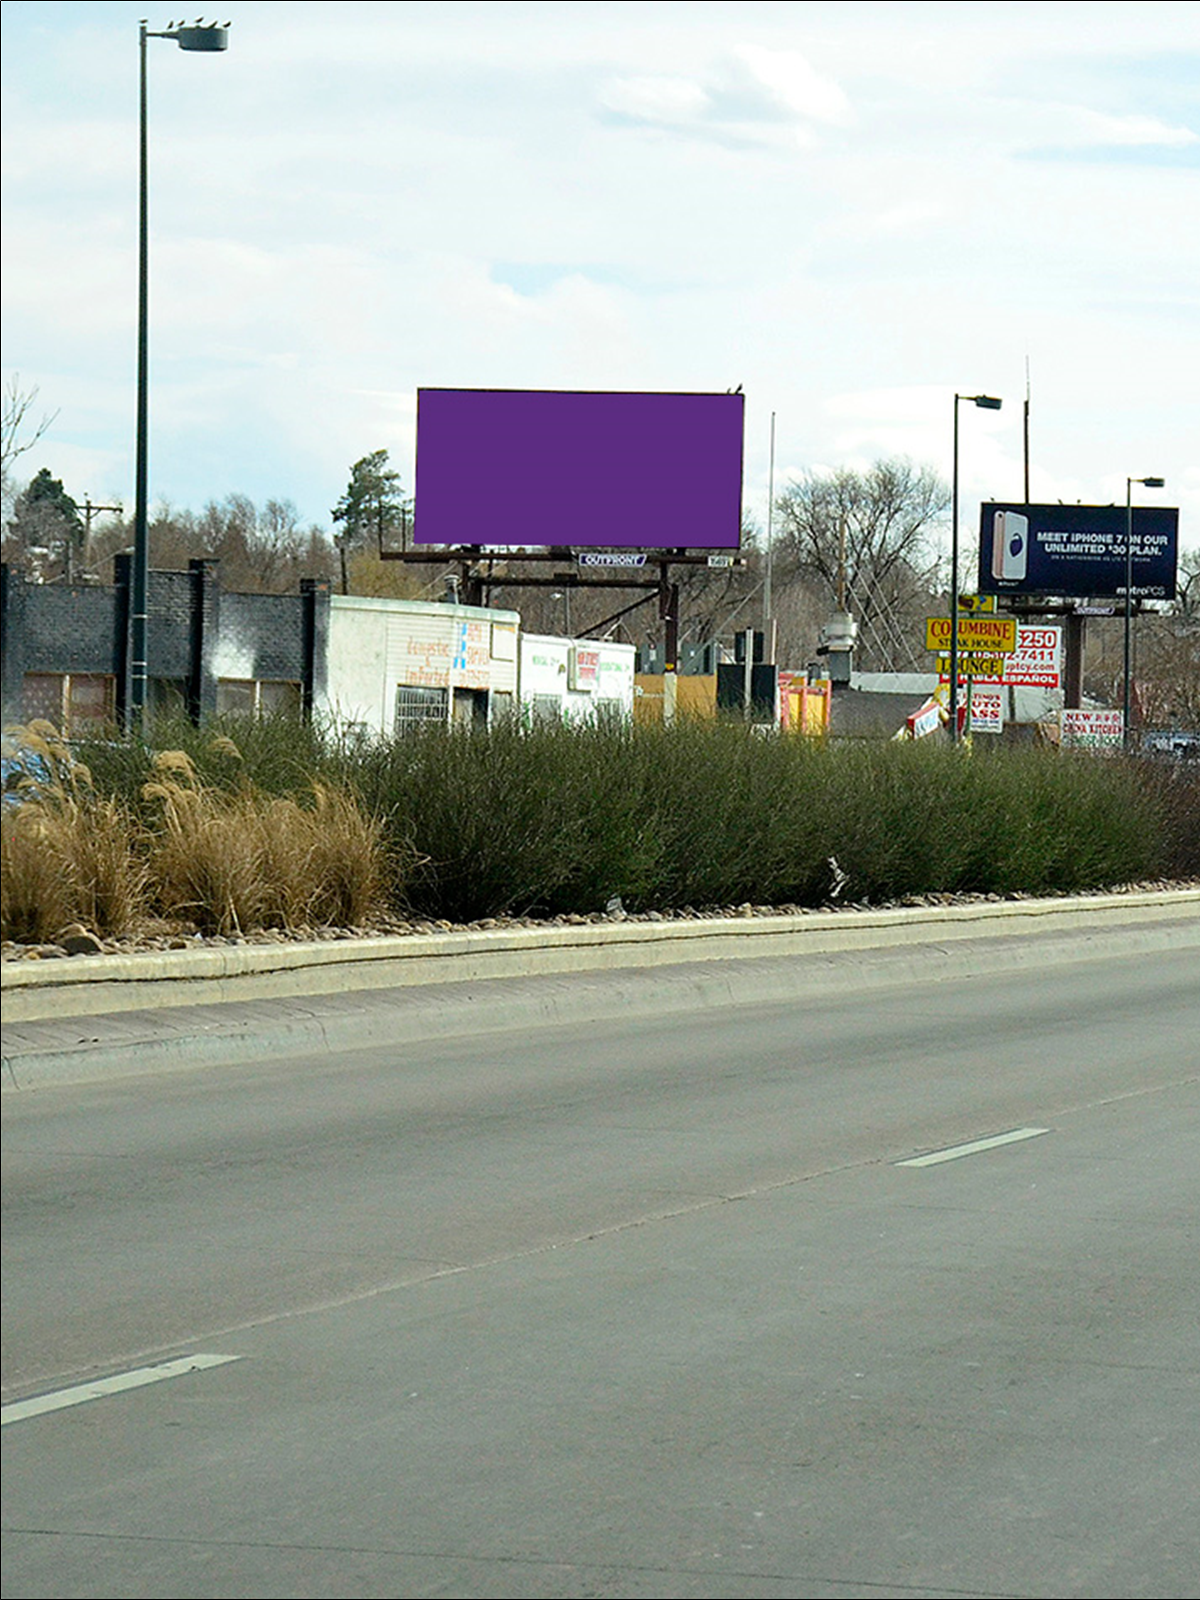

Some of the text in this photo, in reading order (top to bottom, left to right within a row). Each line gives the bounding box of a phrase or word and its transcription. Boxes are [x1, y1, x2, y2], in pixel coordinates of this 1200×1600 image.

[1037, 532, 1068, 542] MEET
[1116, 534, 1122, 544] 7
[1143, 535, 1168, 546] OUR
[1045, 543, 1106, 554] UNLIMITED
[1129, 545, 1162, 556] PLAN.
[1116, 586, 1166, 597] mtroPCS
[931, 620, 1011, 640] COUMBINE
[939, 640, 1004, 649] STAK HOUSE
[940, 658, 999, 674] LUNGE
[1002, 674, 1056, 684] ESPAÑOL
[1066, 713, 1092, 722] NEW
